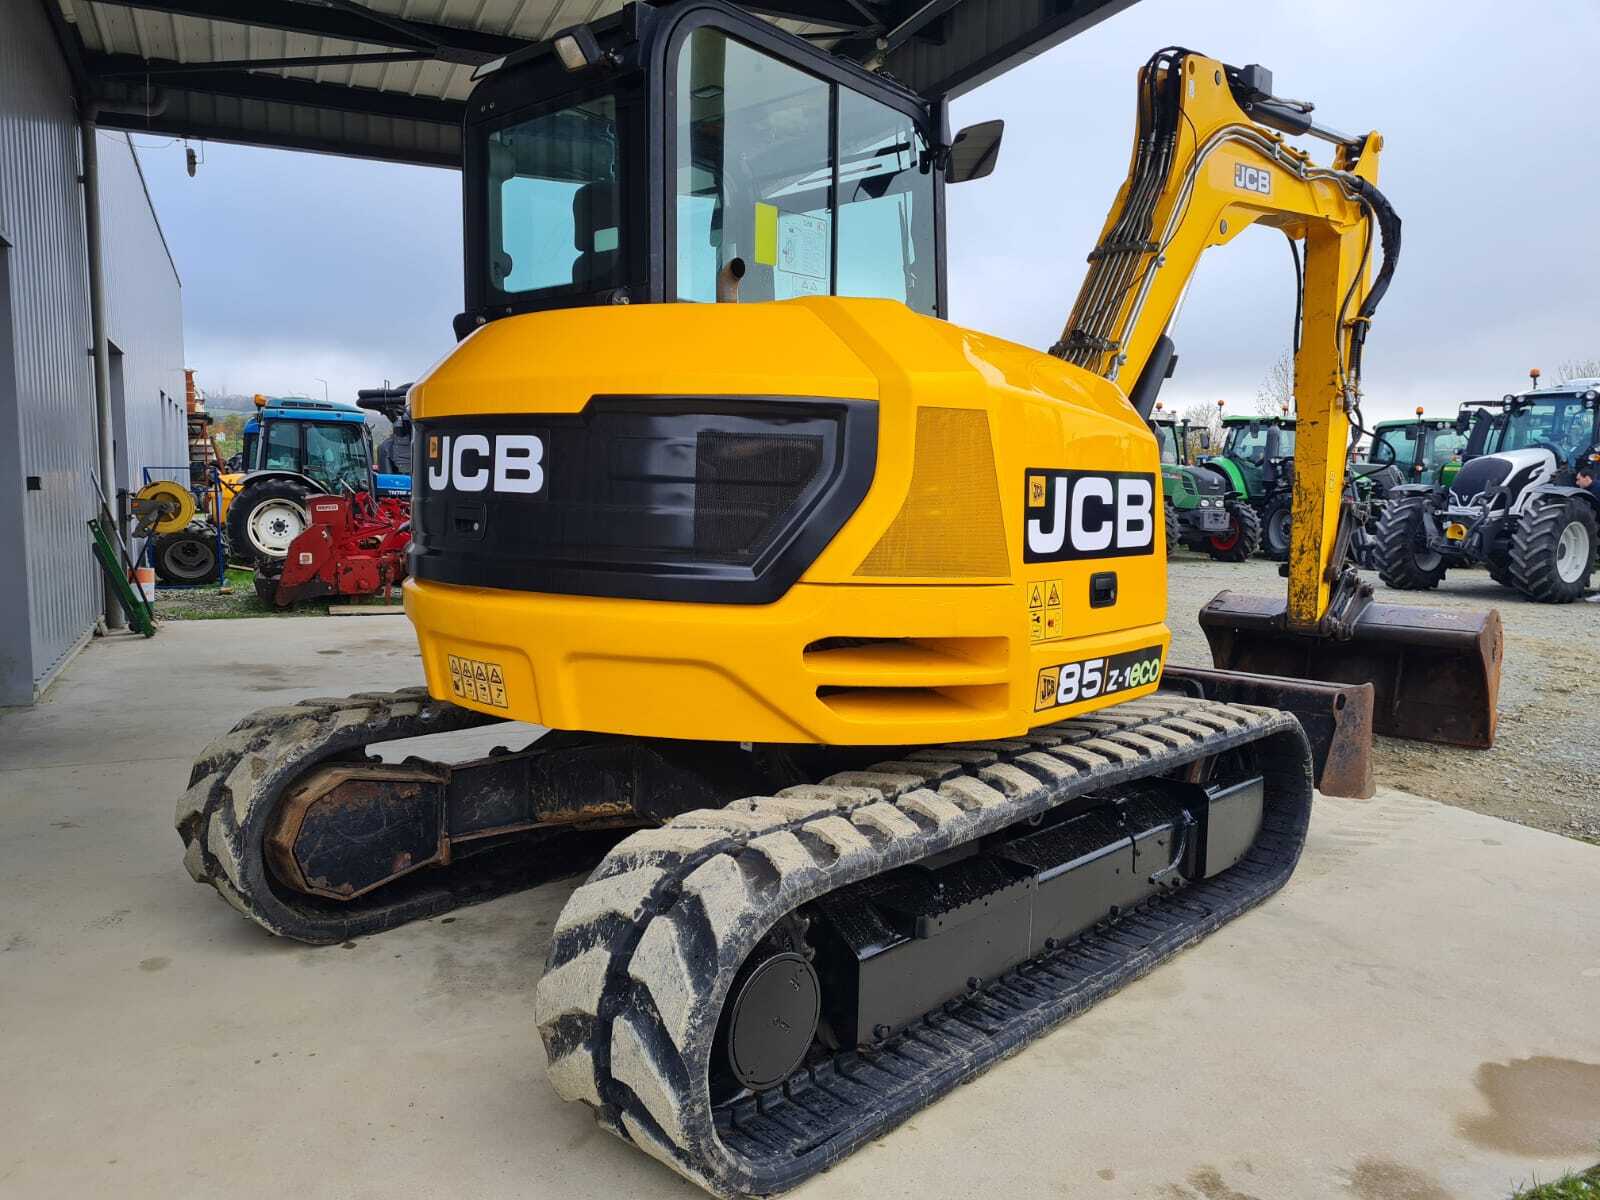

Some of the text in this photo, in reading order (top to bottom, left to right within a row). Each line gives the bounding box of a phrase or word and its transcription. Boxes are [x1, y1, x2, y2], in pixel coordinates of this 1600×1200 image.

[1235, 166, 1270, 193] JCB
[428, 434, 544, 493] JCB
[1027, 476, 1153, 554] JCB
[1040, 676, 1055, 701] JCB
[1057, 658, 1104, 704] 85
